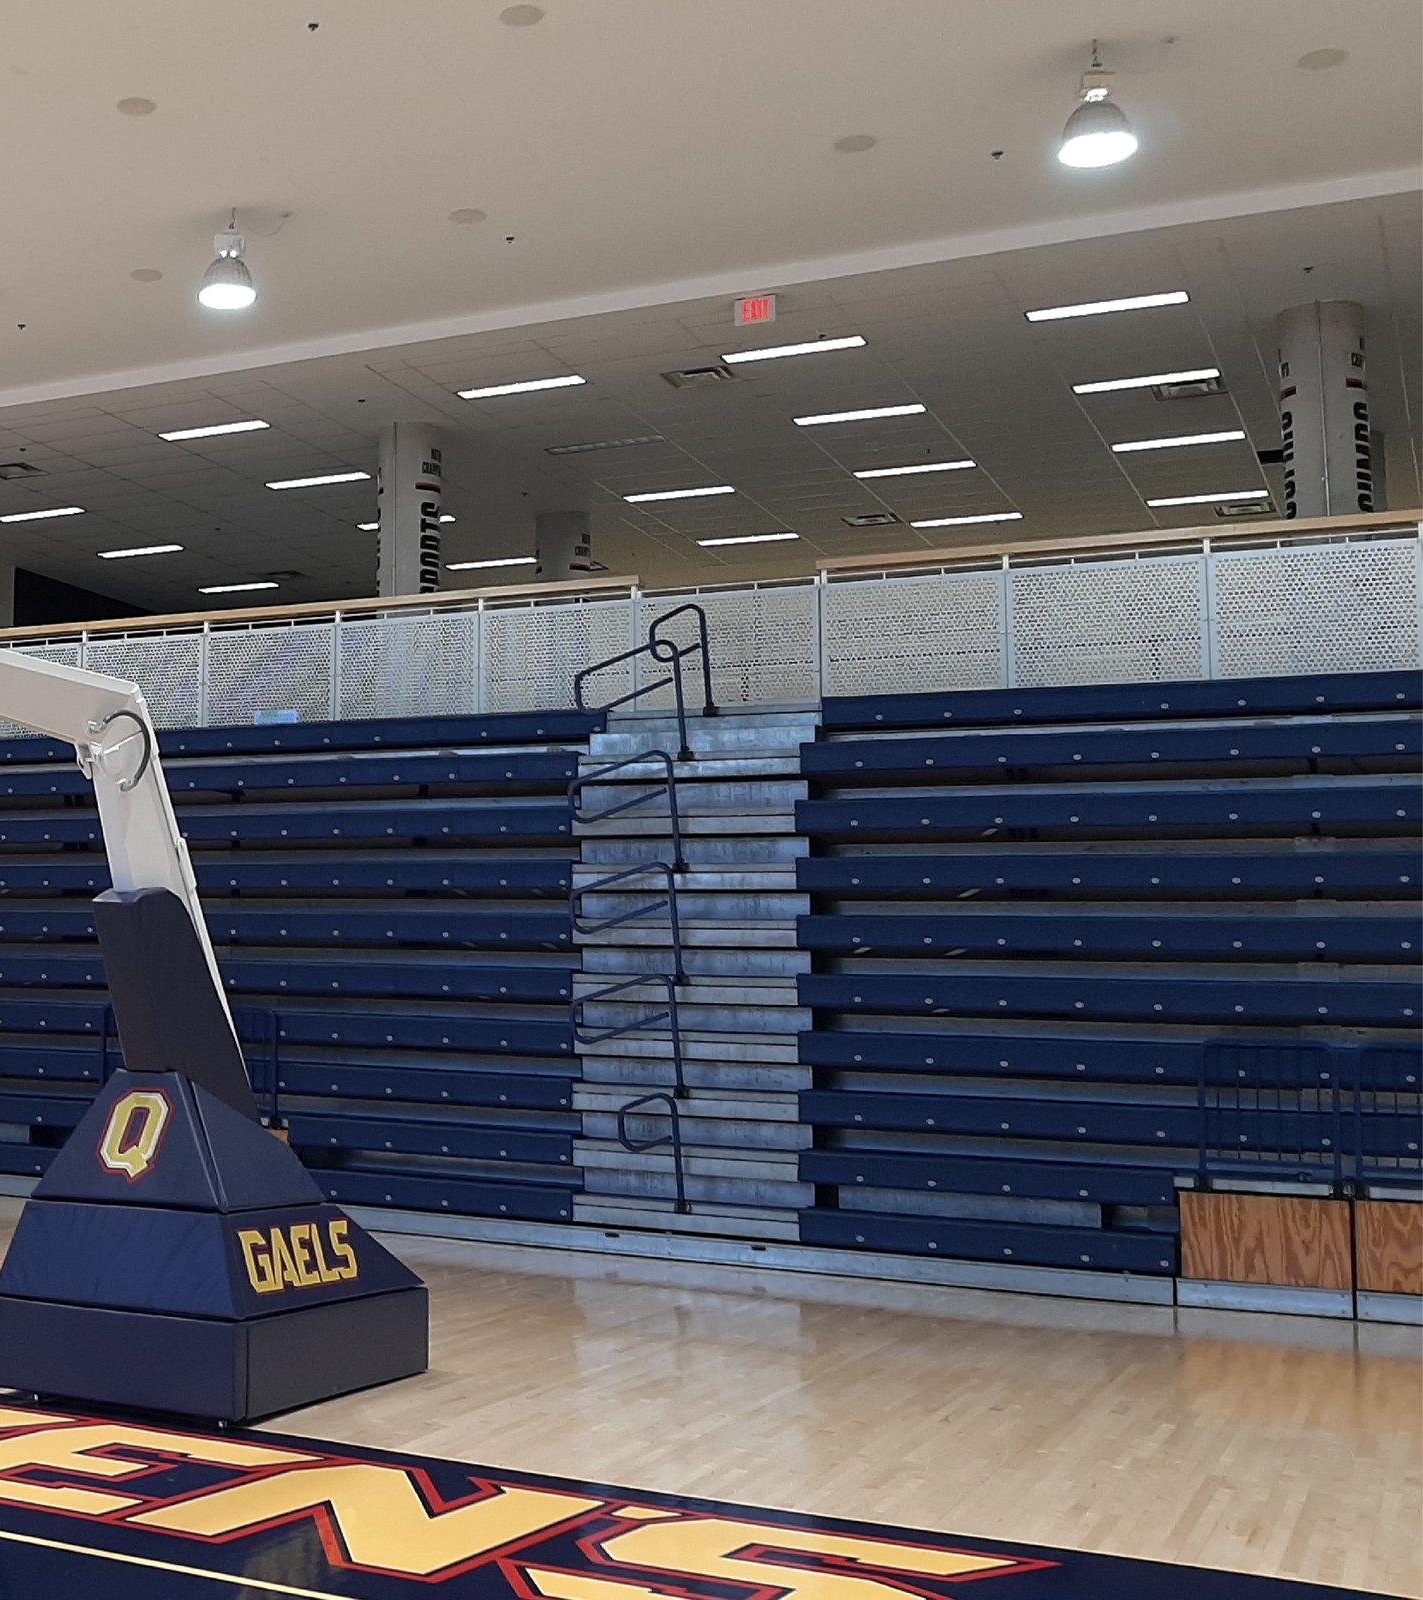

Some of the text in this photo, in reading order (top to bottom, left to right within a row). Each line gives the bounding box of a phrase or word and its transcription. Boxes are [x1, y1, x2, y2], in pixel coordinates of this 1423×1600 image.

[741, 297, 770, 322] EXIT
[96, 1086, 175, 1184] Q
[236, 1217, 360, 1296] GAELS
